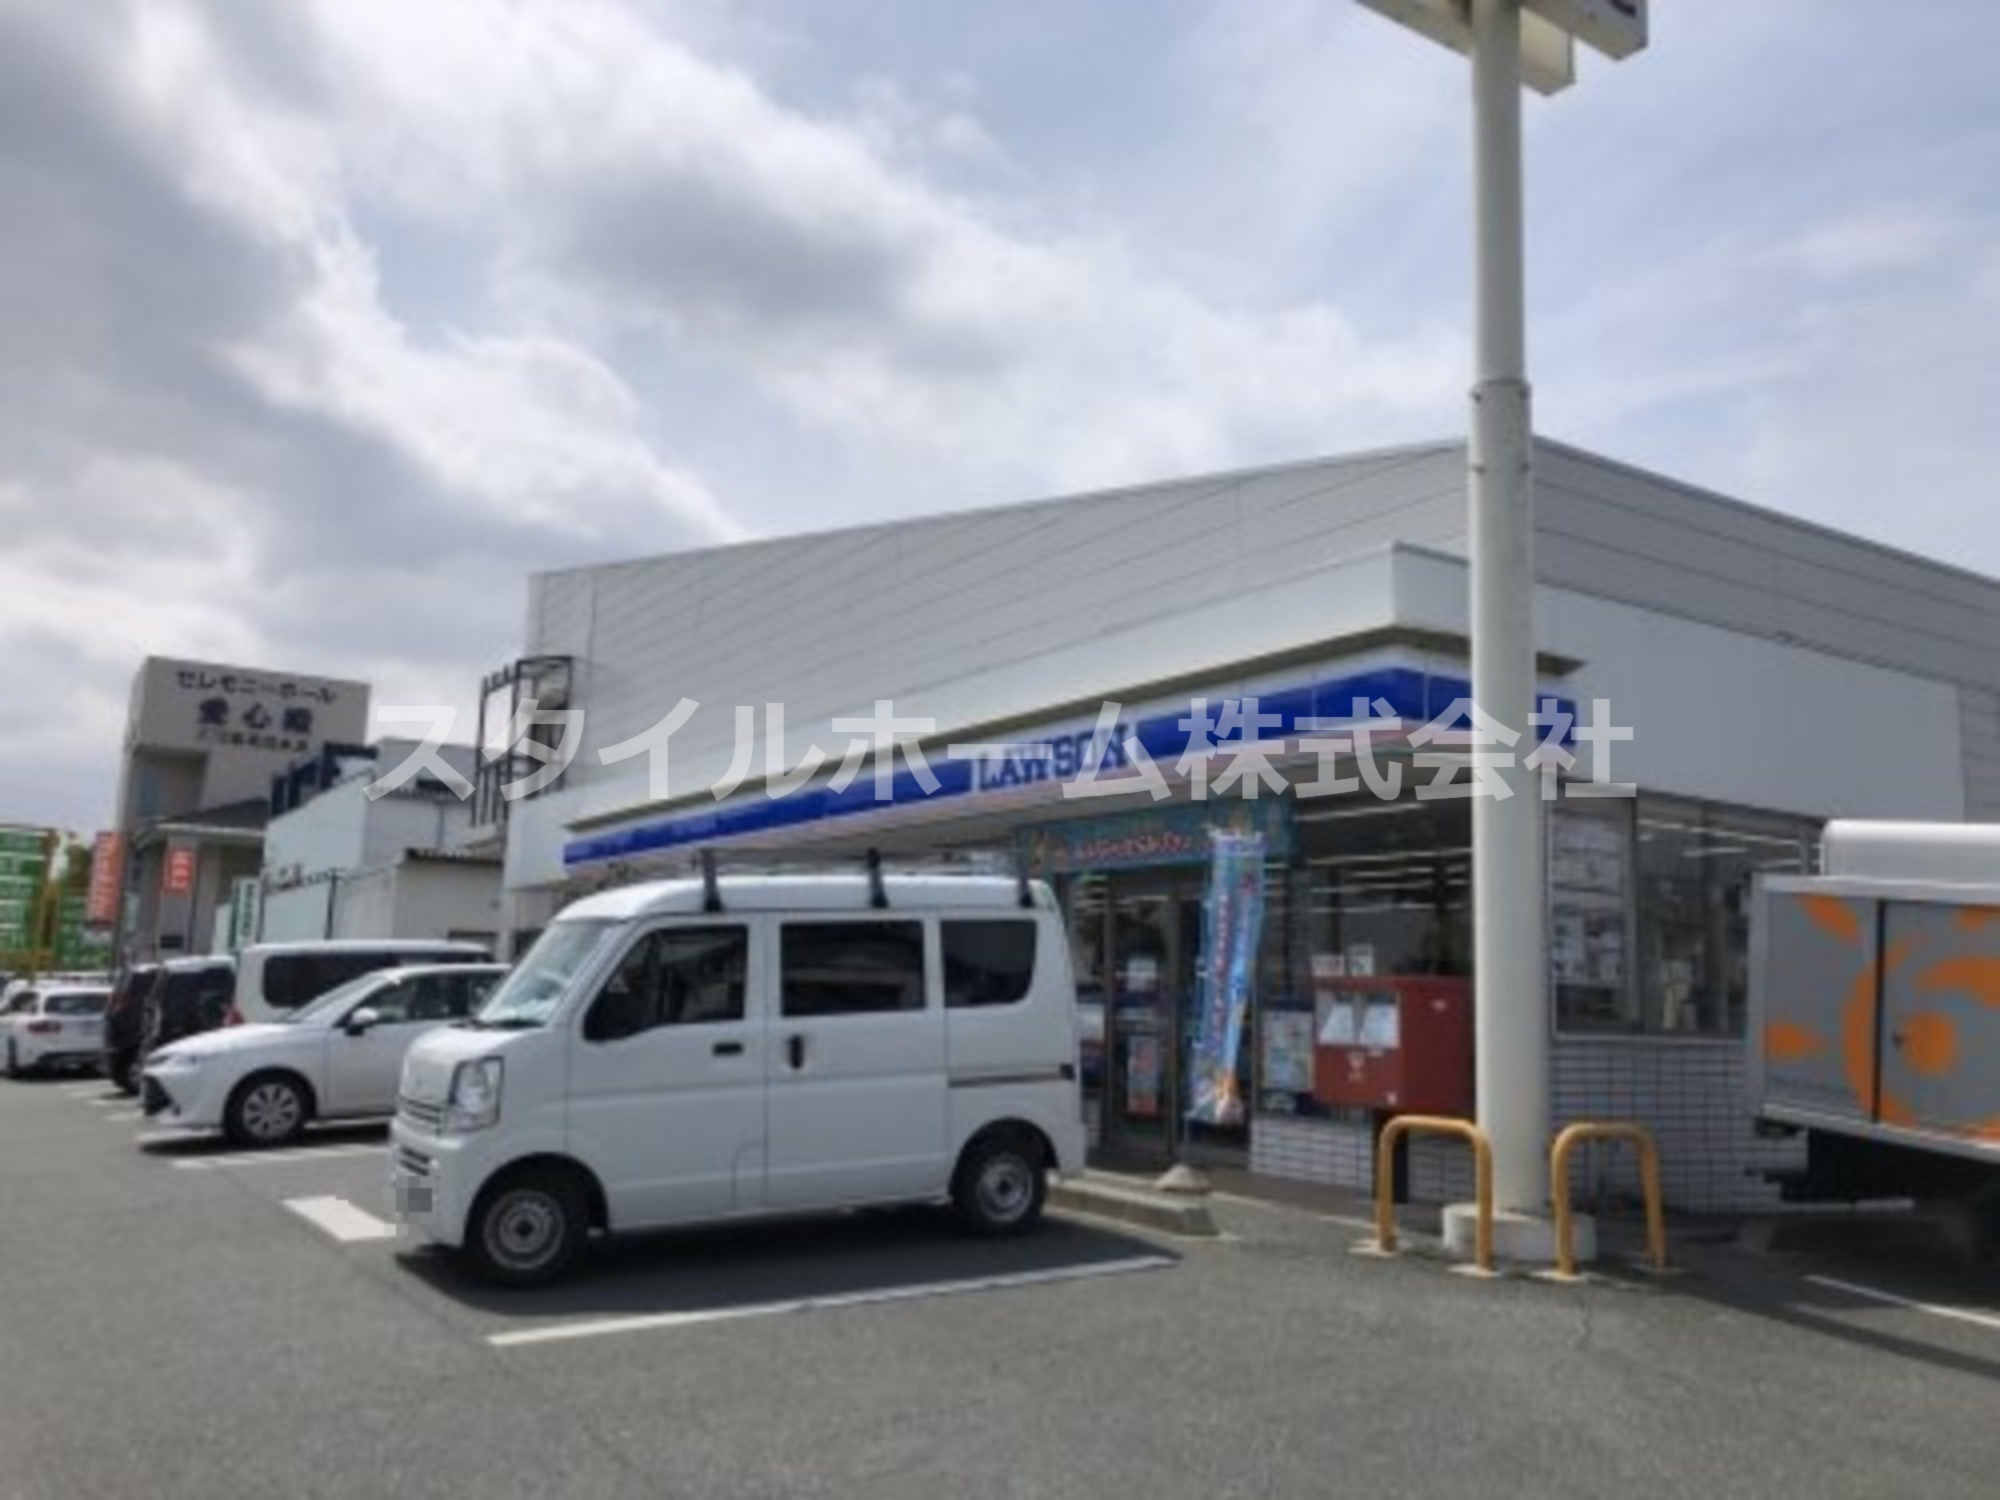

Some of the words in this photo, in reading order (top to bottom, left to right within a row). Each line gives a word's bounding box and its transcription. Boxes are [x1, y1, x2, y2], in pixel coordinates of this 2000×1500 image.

[176, 671, 337, 704] セレモニーホール
[978, 723, 1128, 790] LAWSON
